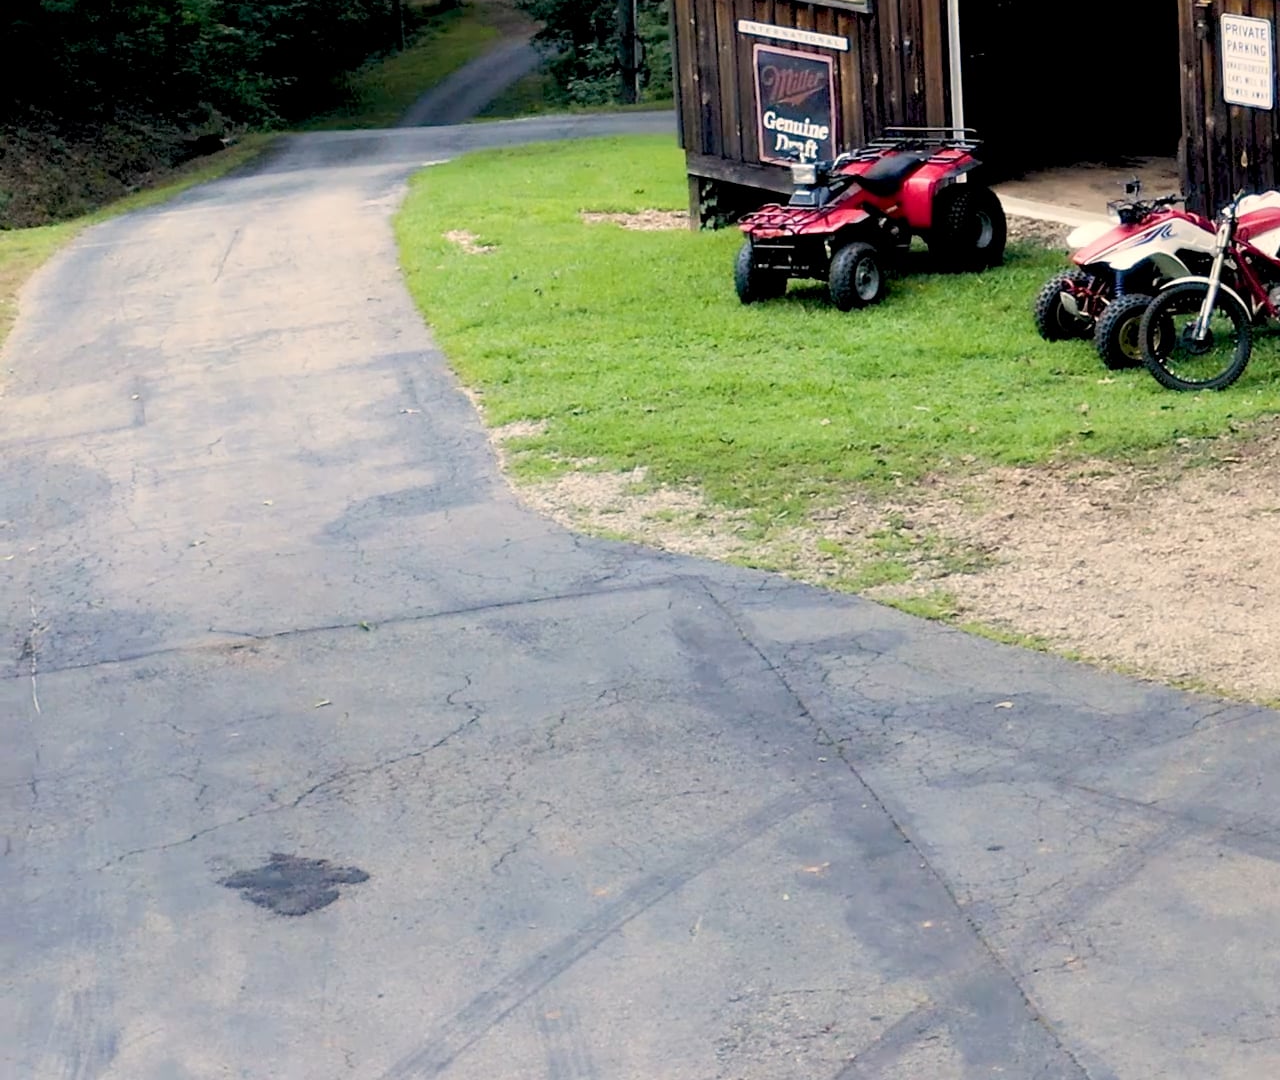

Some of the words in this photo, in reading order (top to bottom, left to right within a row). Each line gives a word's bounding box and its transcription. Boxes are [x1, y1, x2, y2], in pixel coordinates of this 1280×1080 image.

[744, 23, 841, 47] INTERNATIONAL
[1225, 23, 1267, 40] PRIVATE
[1227, 40, 1267, 56] PARKING
[762, 65, 825, 102] Miller
[763, 110, 829, 140] Genuine
